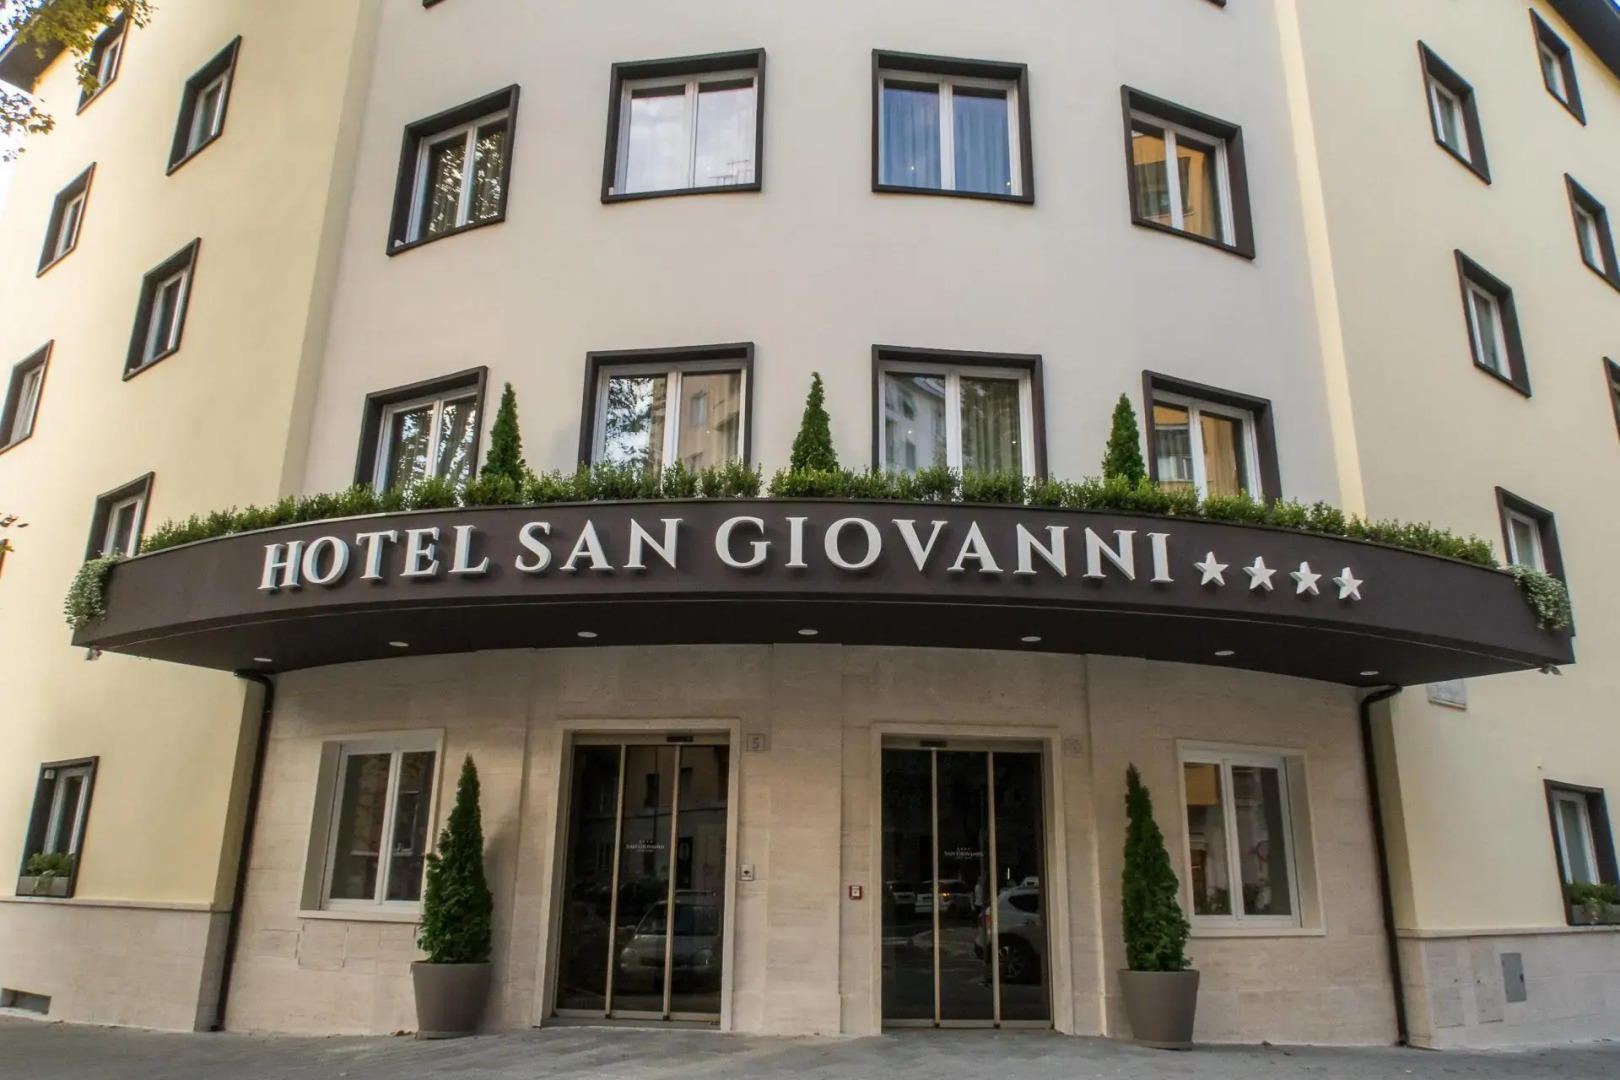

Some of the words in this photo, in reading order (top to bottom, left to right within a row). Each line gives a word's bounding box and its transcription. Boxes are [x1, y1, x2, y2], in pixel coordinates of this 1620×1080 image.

[258, 524, 489, 590] HOTEL
[515, 518, 683, 573] SAN
[715, 516, 1174, 582] GIOVANNI
